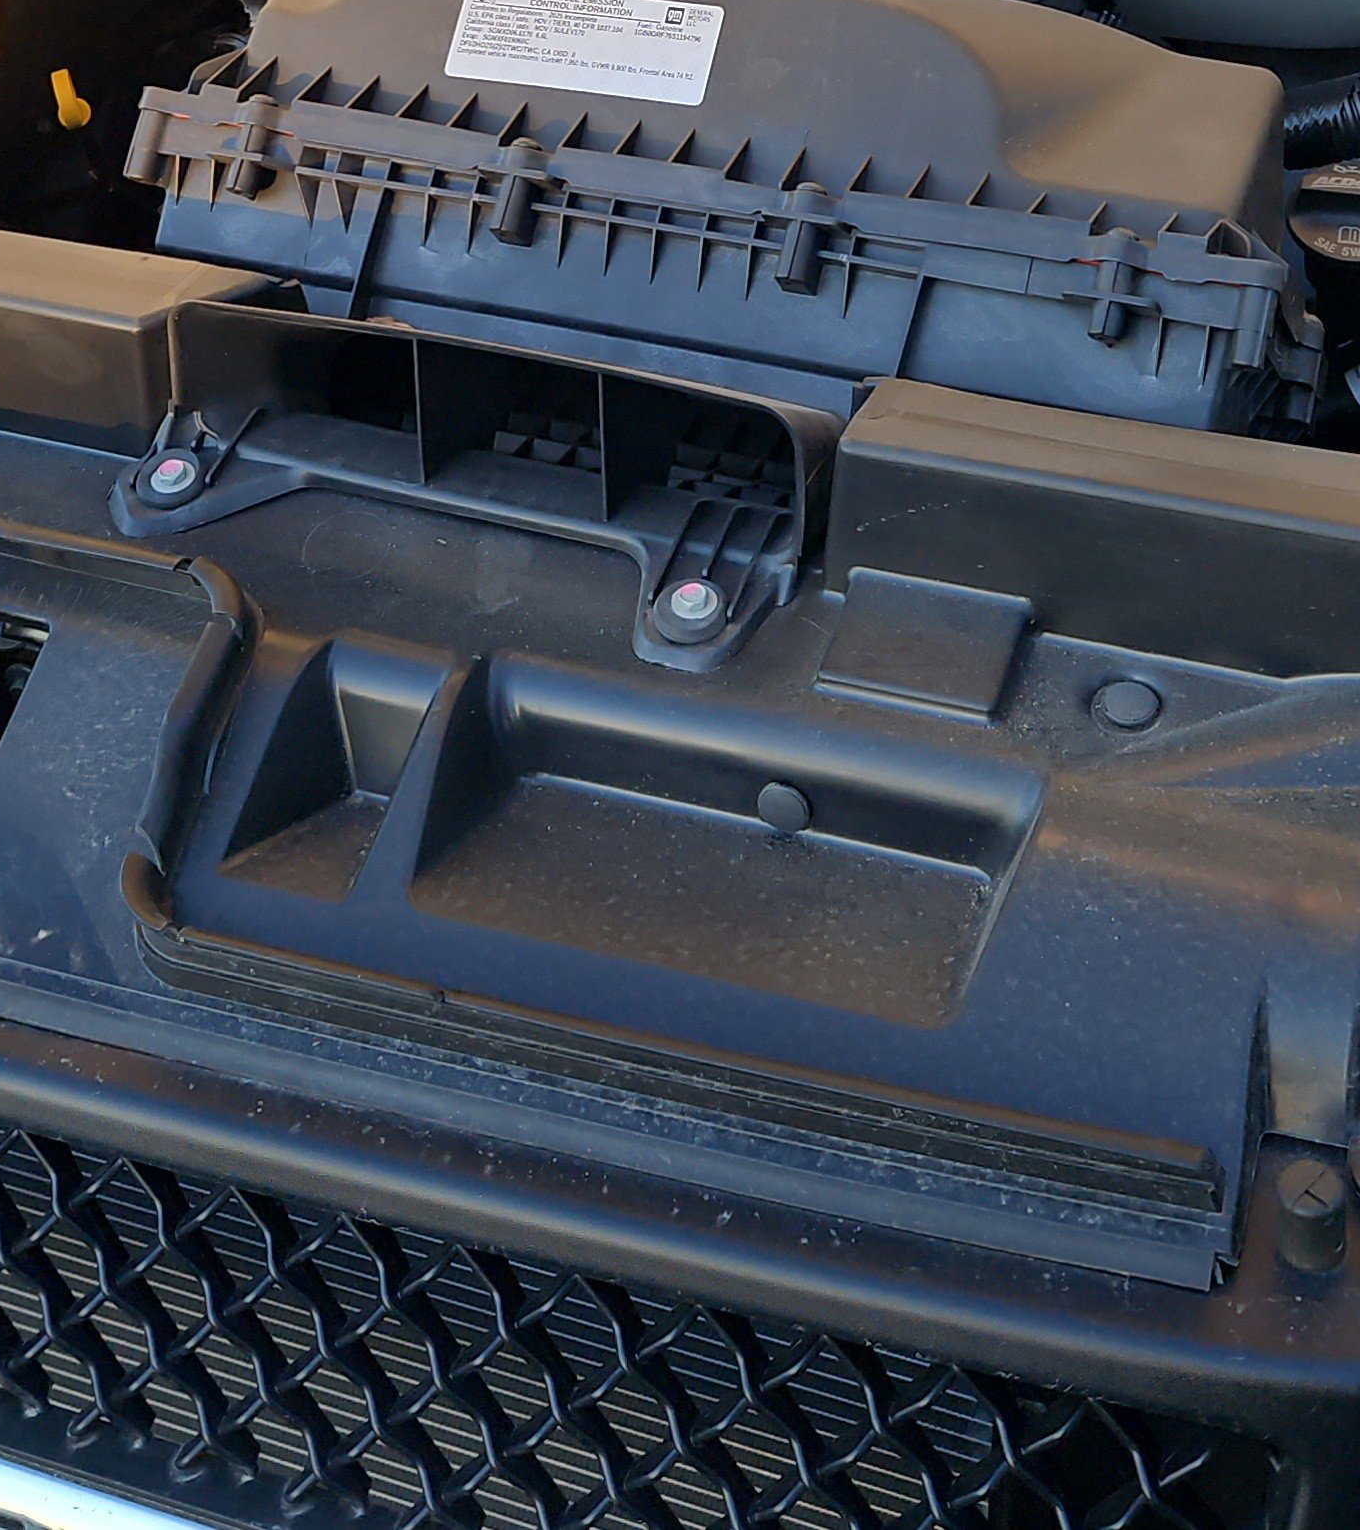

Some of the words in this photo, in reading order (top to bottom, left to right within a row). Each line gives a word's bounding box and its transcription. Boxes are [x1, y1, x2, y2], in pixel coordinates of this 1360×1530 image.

[530, 0, 570, 9] CONTROL
[573, 3, 633, 16] INFORMATION
[689, 8, 714, 16] GENERAL
[656, 24, 683, 32] Gasoline
[1313, 237, 1338, 253] SAE
